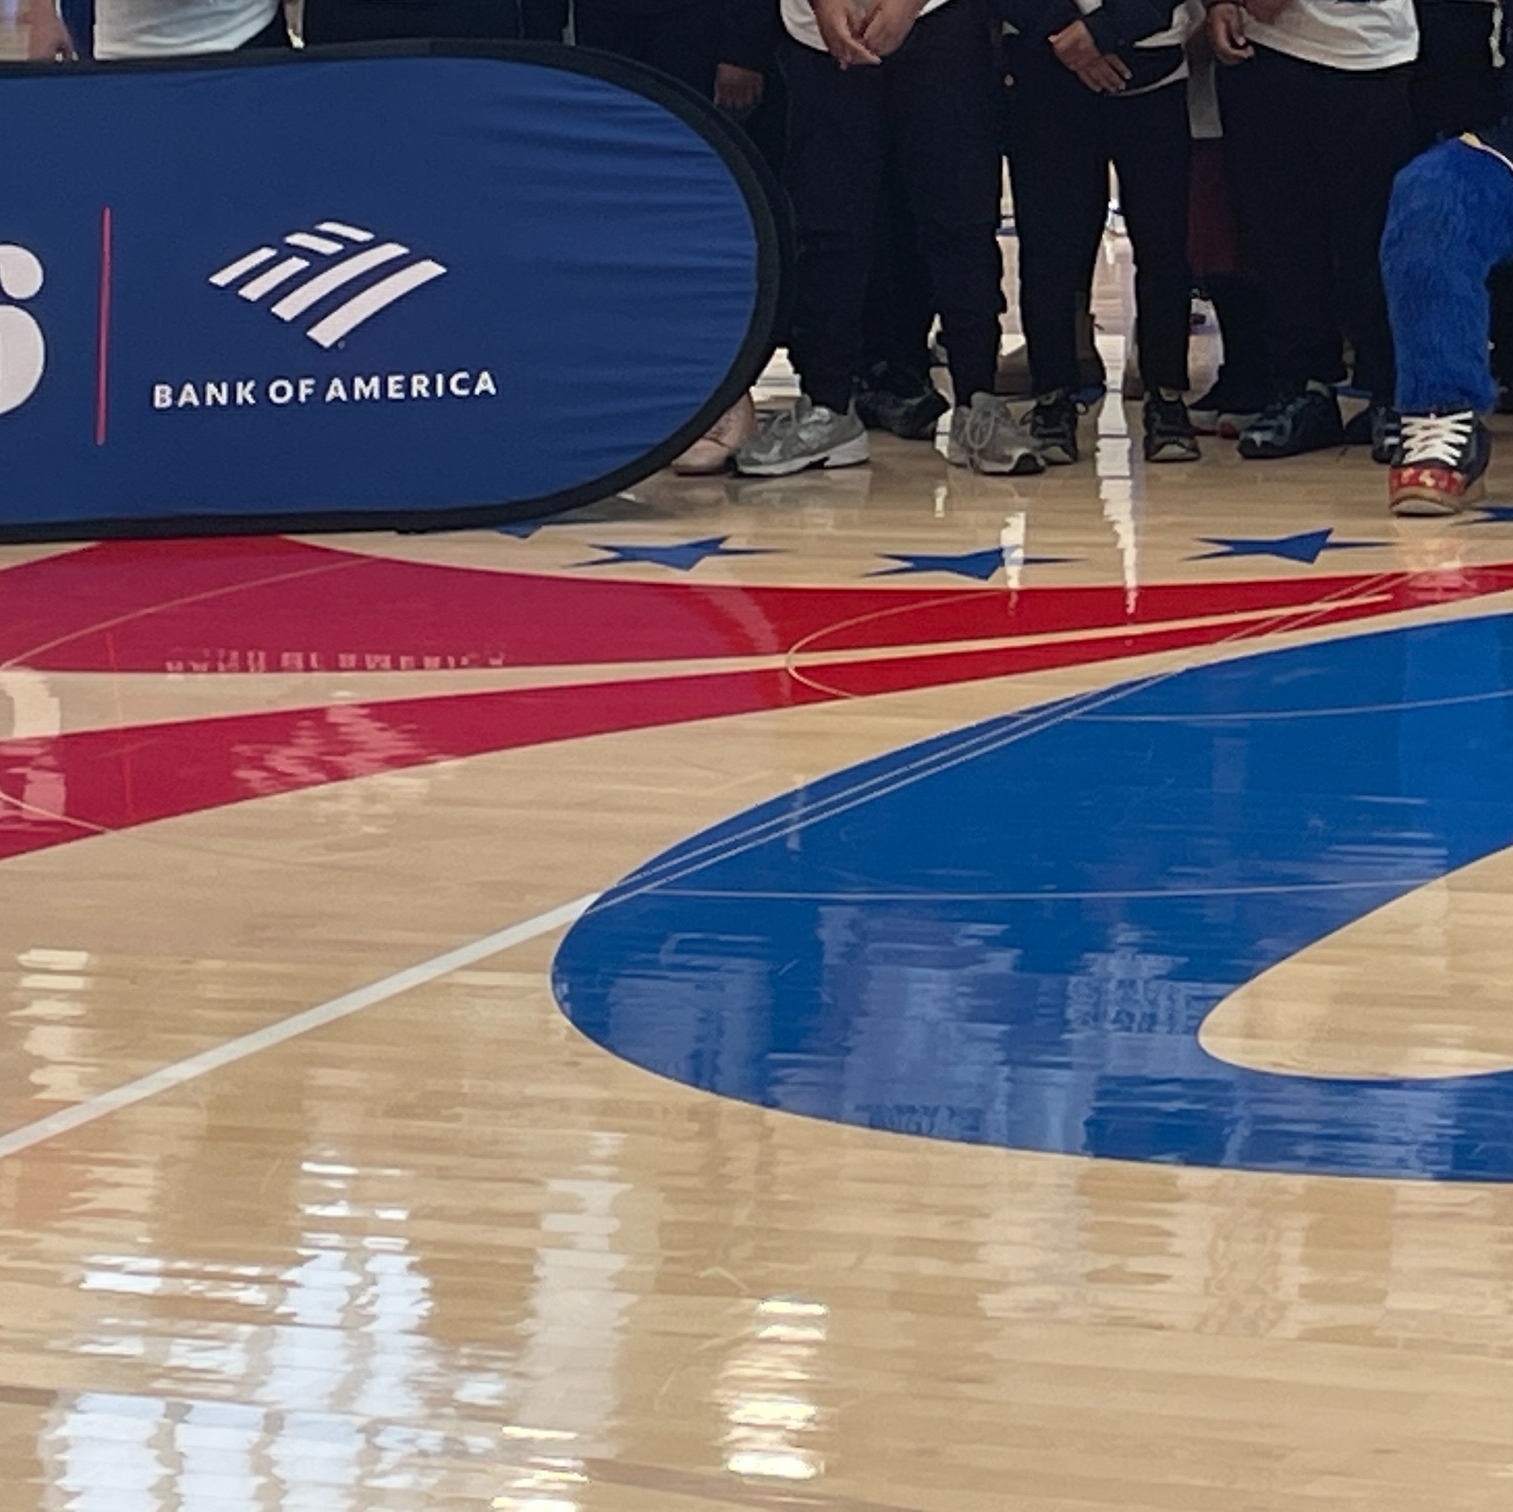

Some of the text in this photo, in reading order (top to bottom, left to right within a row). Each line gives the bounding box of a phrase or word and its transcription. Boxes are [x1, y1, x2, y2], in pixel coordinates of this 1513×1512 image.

[153, 370, 497, 409] BANK OF AMERICA
